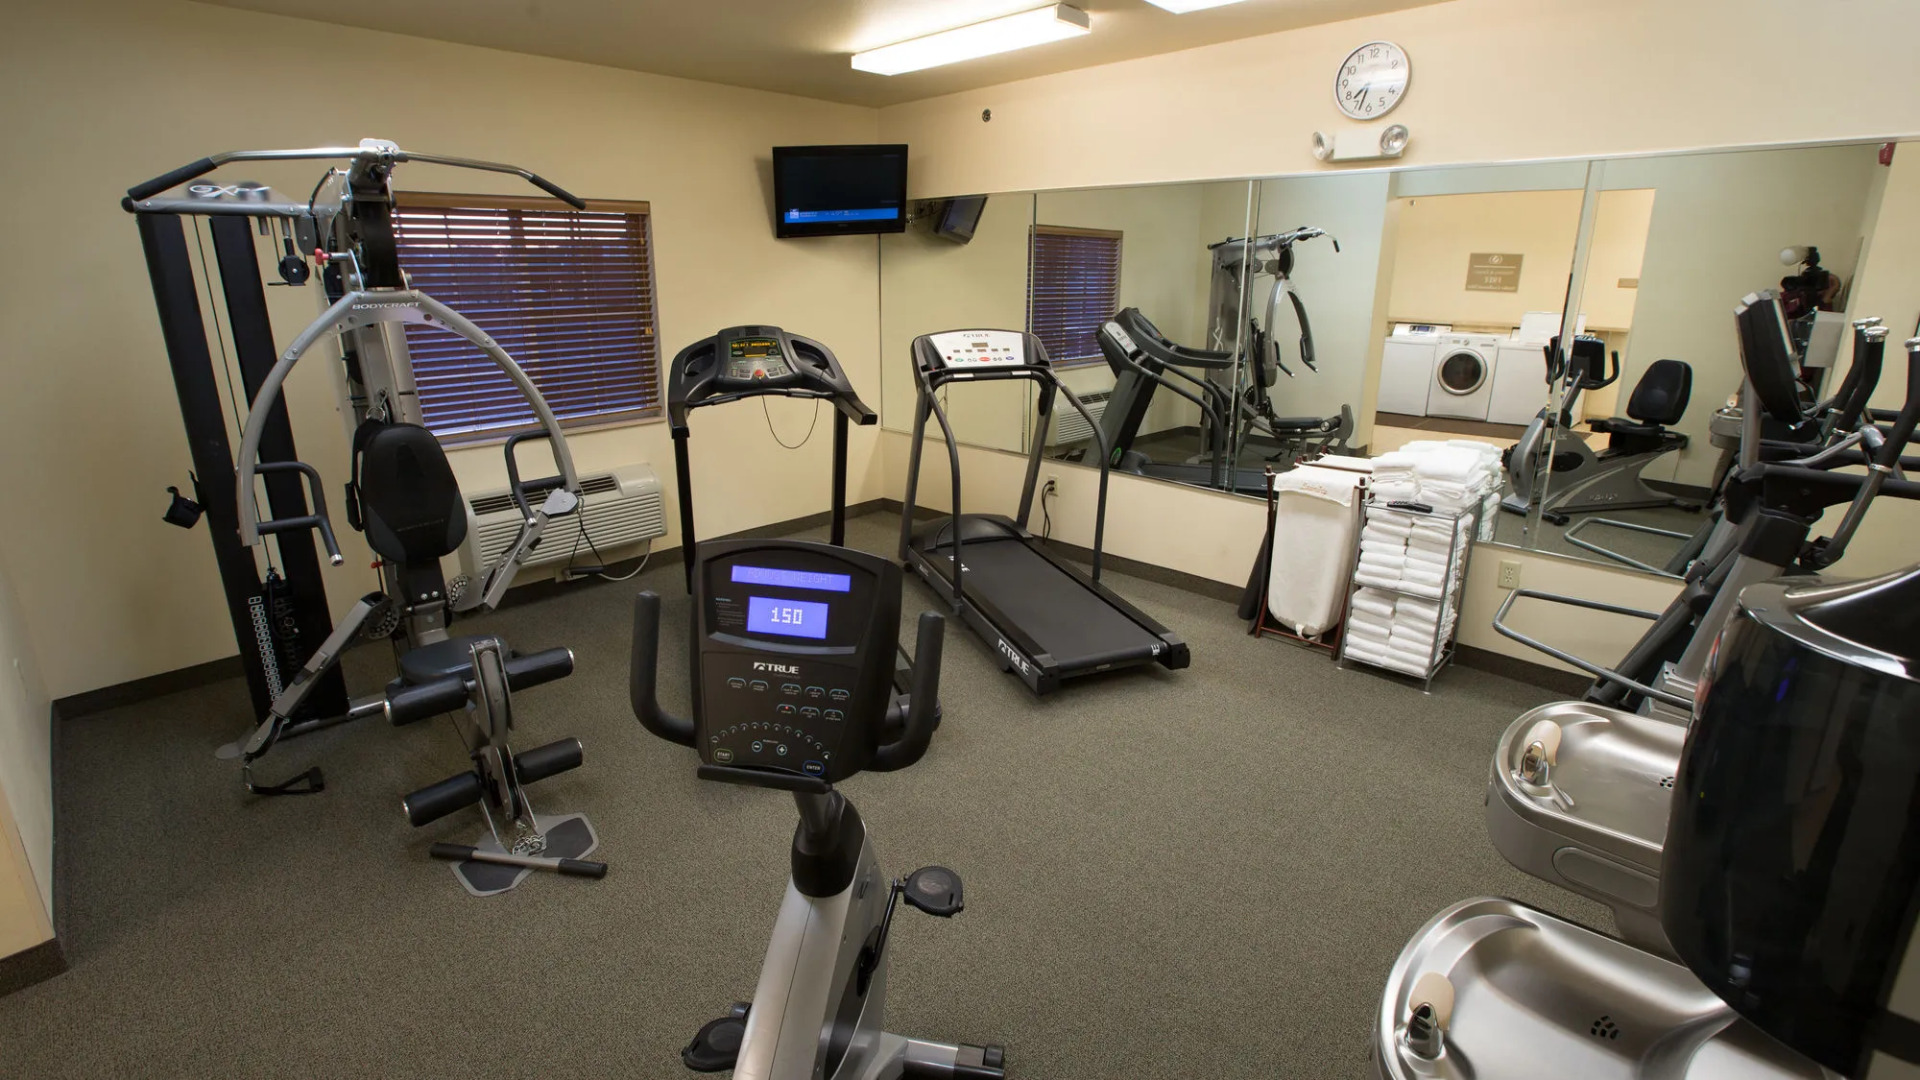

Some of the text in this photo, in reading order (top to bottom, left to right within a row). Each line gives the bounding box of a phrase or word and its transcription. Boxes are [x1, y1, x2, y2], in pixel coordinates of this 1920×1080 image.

[1369, 48, 1380, 58] 12
[1357, 55, 1365, 64] 11
[1391, 60, 1398, 69] 2
[1345, 66, 1356, 76] 10
[1342, 79, 1349, 89] 9
[1388, 86, 1396, 95] 4
[1345, 91, 1352, 100] 8
[1353, 100, 1359, 109] 7
[1379, 97, 1385, 107] 5
[1365, 103, 1372, 112] 6
[352, 301, 420, 310] BODYCRAFT
[771, 606, 802, 625] 150
[1006, 645, 1030, 676] TRUE
[766, 662, 800, 674] TRUE
